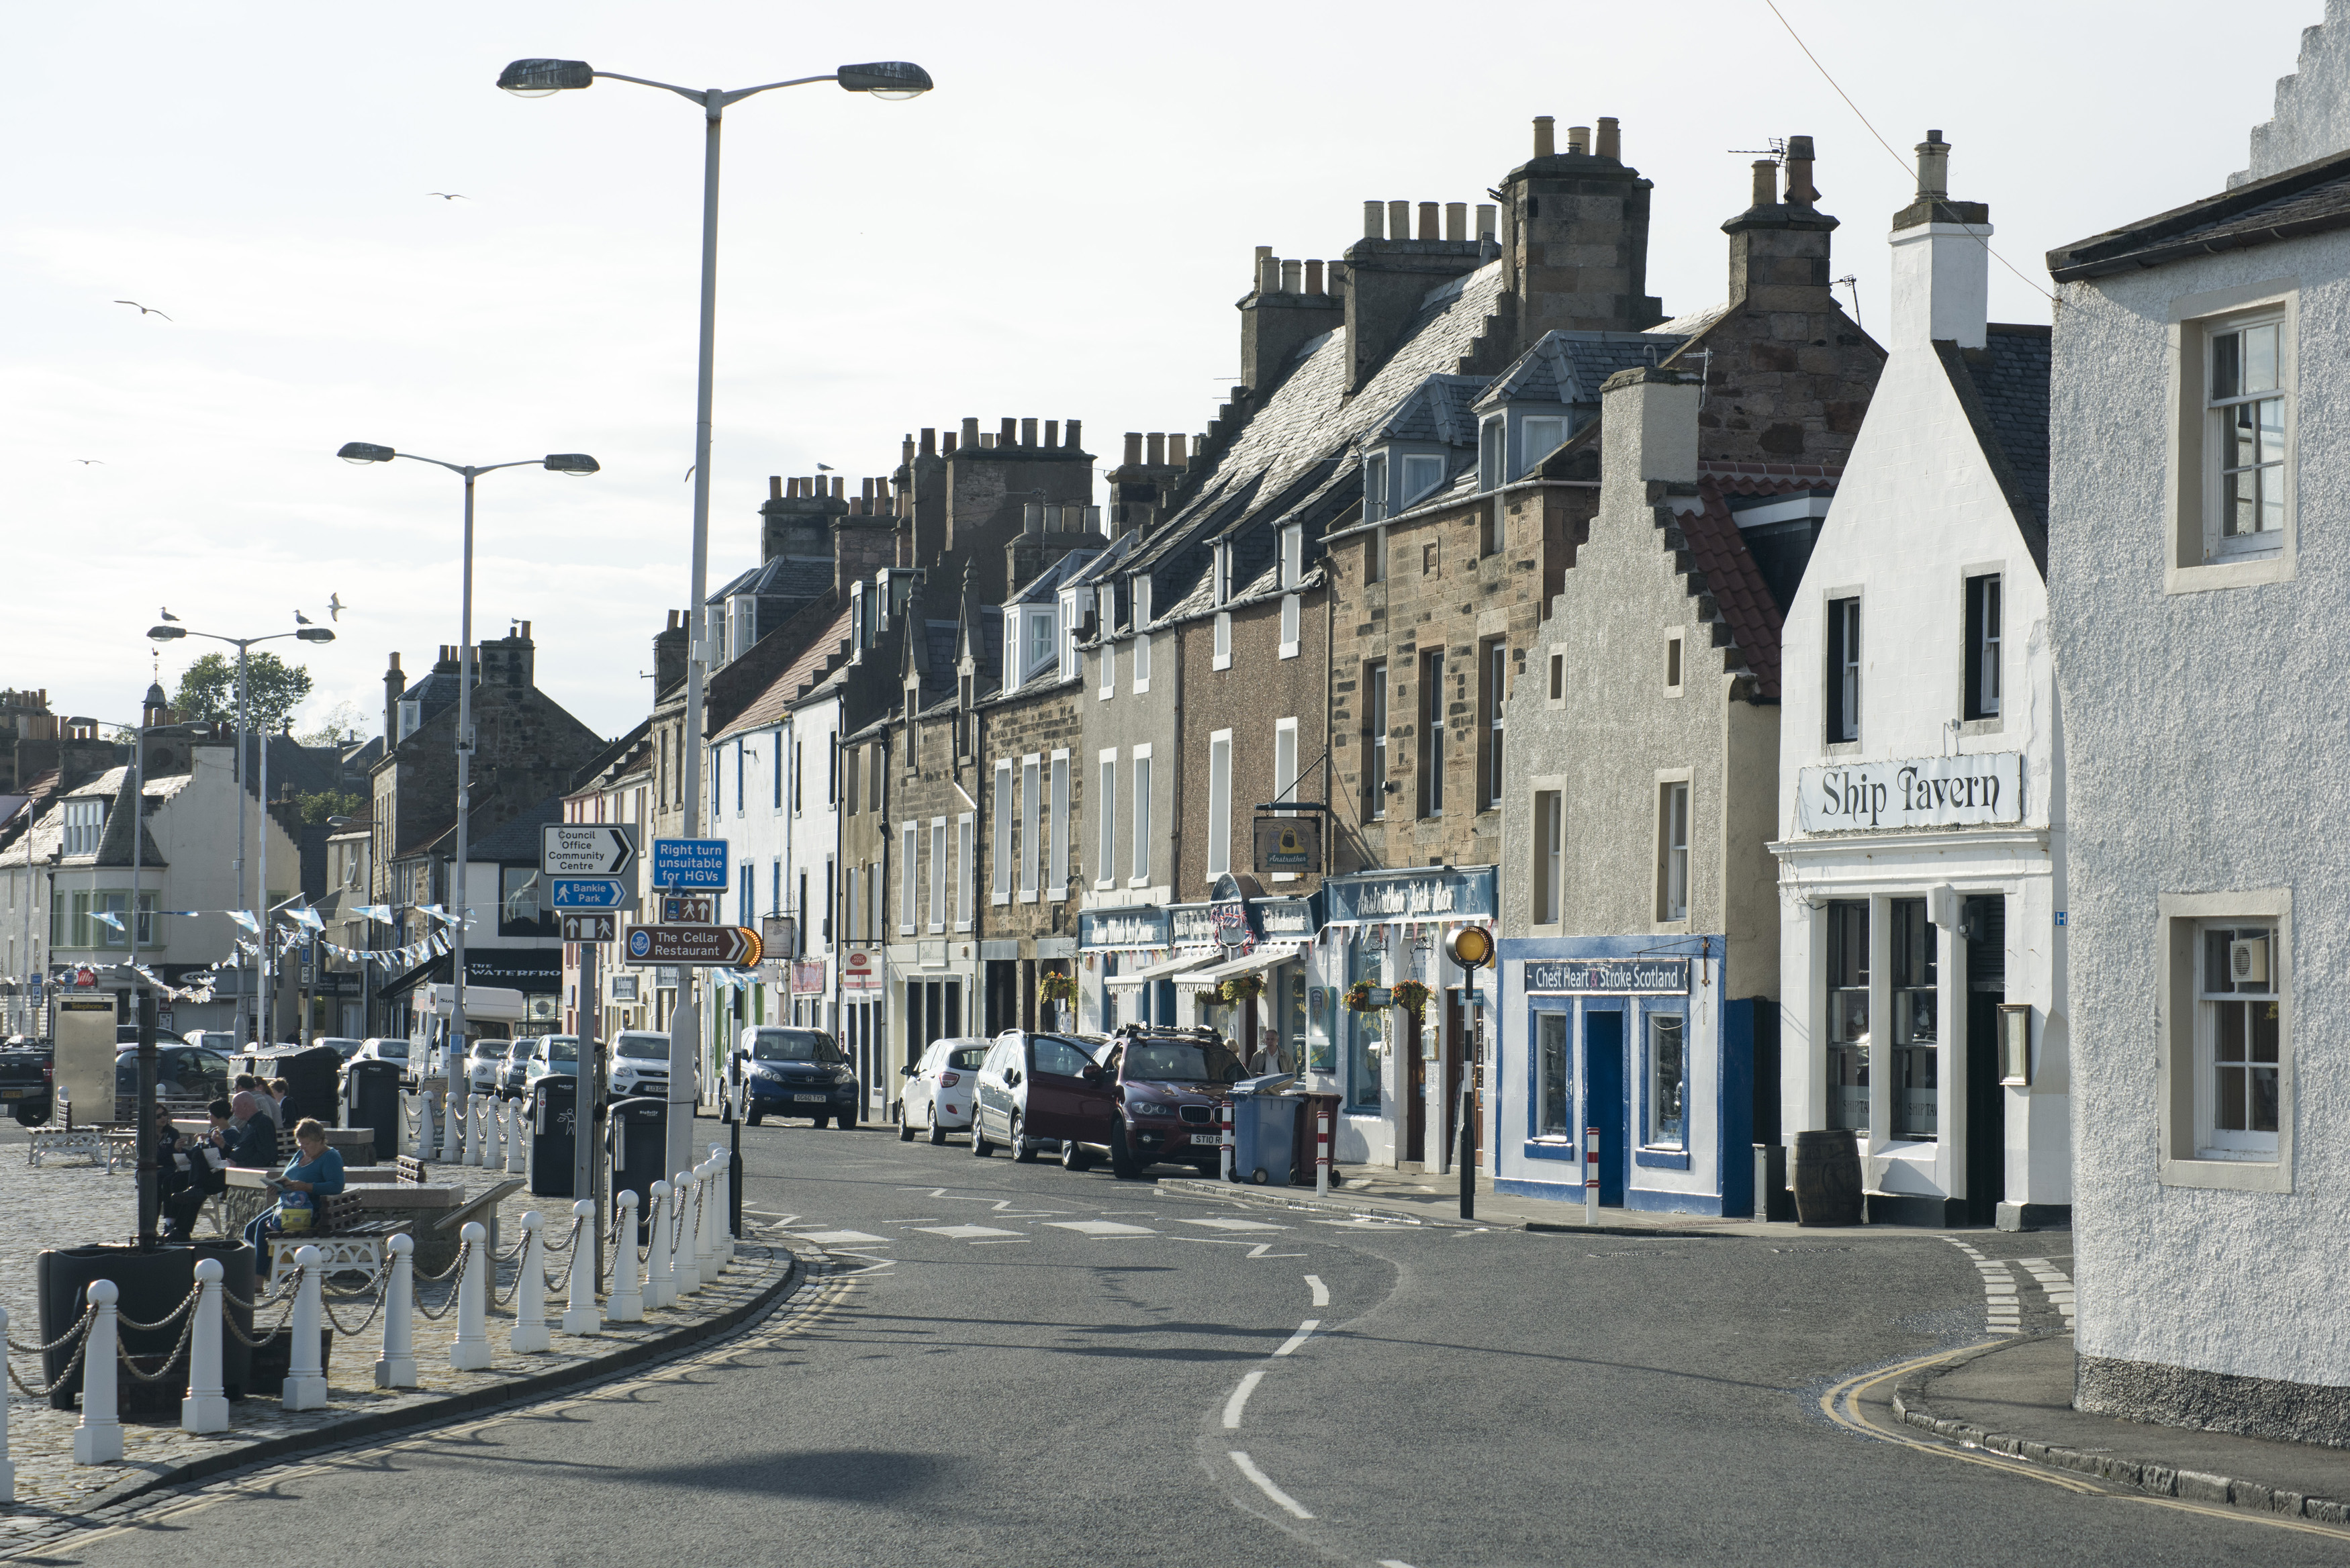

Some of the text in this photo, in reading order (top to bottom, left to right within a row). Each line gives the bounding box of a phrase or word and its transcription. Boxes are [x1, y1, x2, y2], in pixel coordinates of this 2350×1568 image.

[1821, 766, 2000, 826] Ship Tavern
[558, 831, 596, 839] Council
[561, 841, 592, 850] Office
[660, 844, 722, 857] Right turn
[549, 851, 605, 861] Community
[1269, 854, 1306, 863] Anstruther
[559, 861, 594, 870] Centre
[659, 858, 722, 869] unsuitable
[662, 870, 718, 881] for HGVs
[573, 883, 606, 892] Bankie
[578, 893, 601, 902] Park
[1357, 879, 1454, 917] Anstruther Fish Bar
[2057, 912, 2067, 925] H
[656, 932, 719, 943] The Cellar
[655, 945, 720, 956] Restaurant
[79, 972, 94, 985] illy
[1536, 965, 1678, 987] Chest Heart & Stroke Scotland
[70, 1002, 104, 1010] Telephone
[1843, 1100, 1859, 1114] SHIP
[1908, 1103, 1938, 1117] SHIP TAV
[1196, 1135, 1213, 1144] ST10
